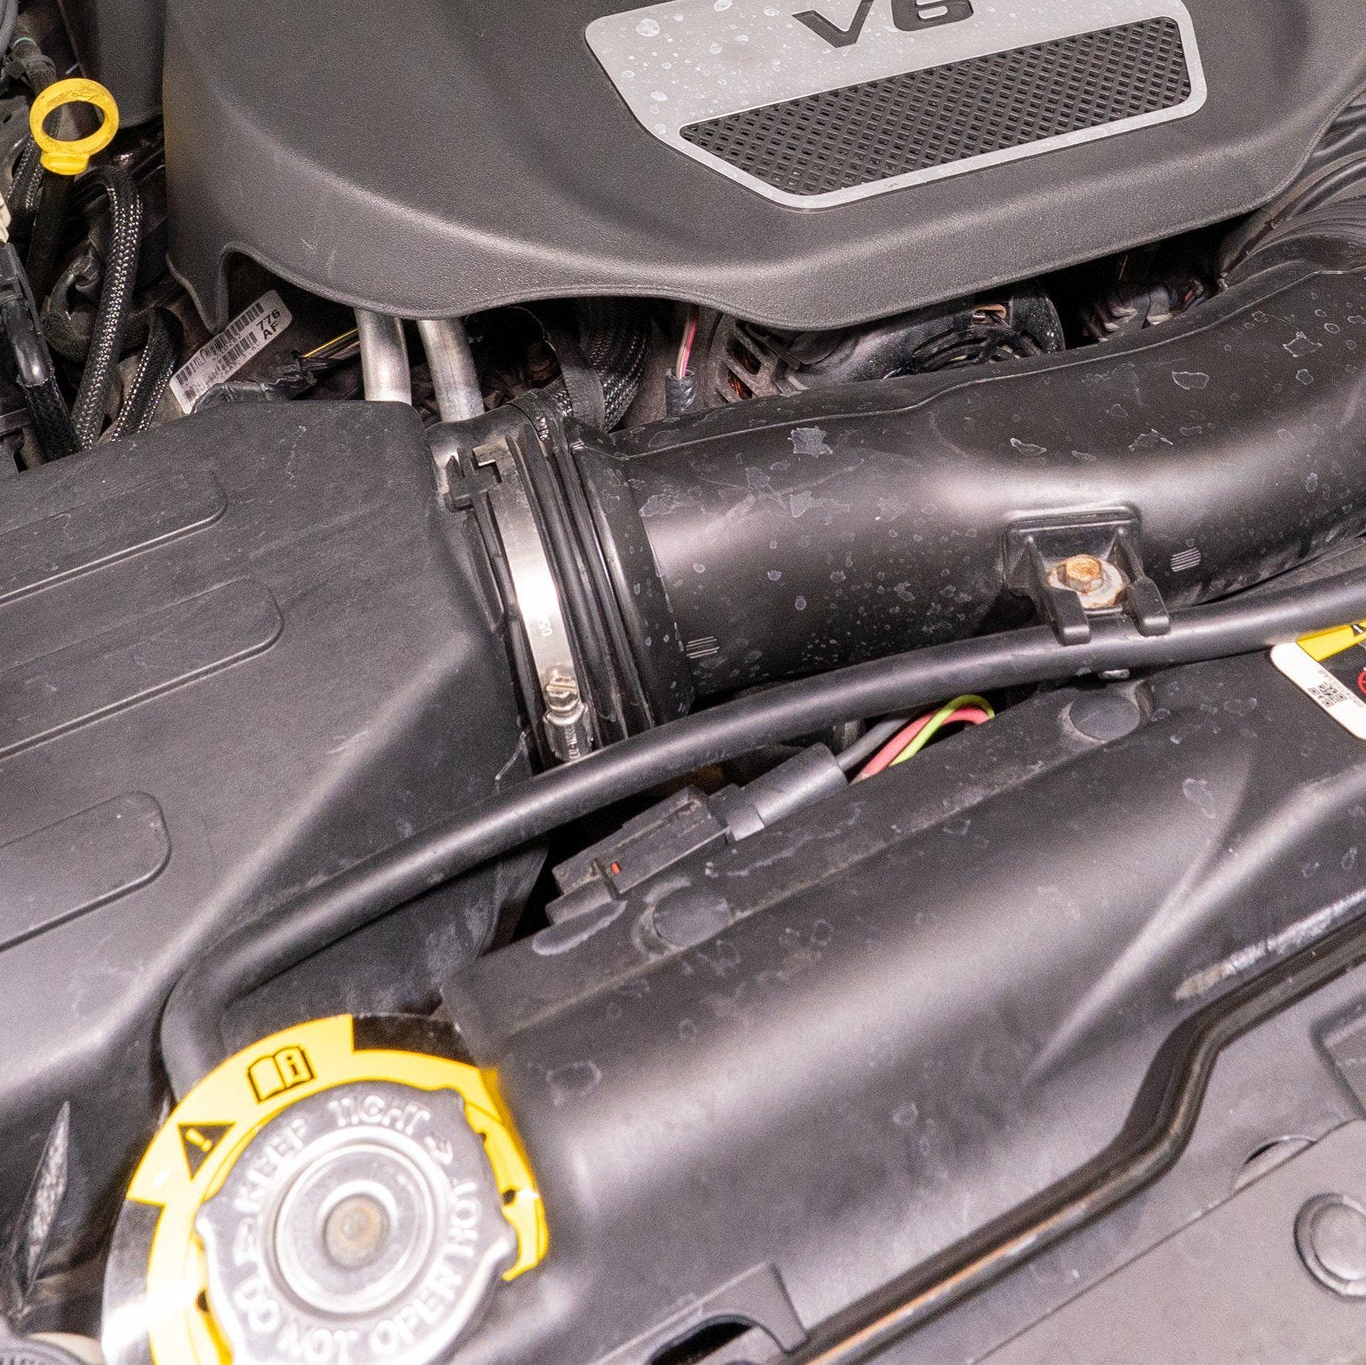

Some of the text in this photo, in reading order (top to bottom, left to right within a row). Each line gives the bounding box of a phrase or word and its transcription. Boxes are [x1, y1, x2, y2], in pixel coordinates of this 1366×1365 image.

[256, 309, 281, 331] 776
[262, 322, 279, 340] AF
[234, 1095, 431, 1213] KEEP TIGHT
[233, 1278, 280, 1333] DO
[276, 1322, 360, 1365] NOT
[369, 1263, 464, 1354] OPEN
